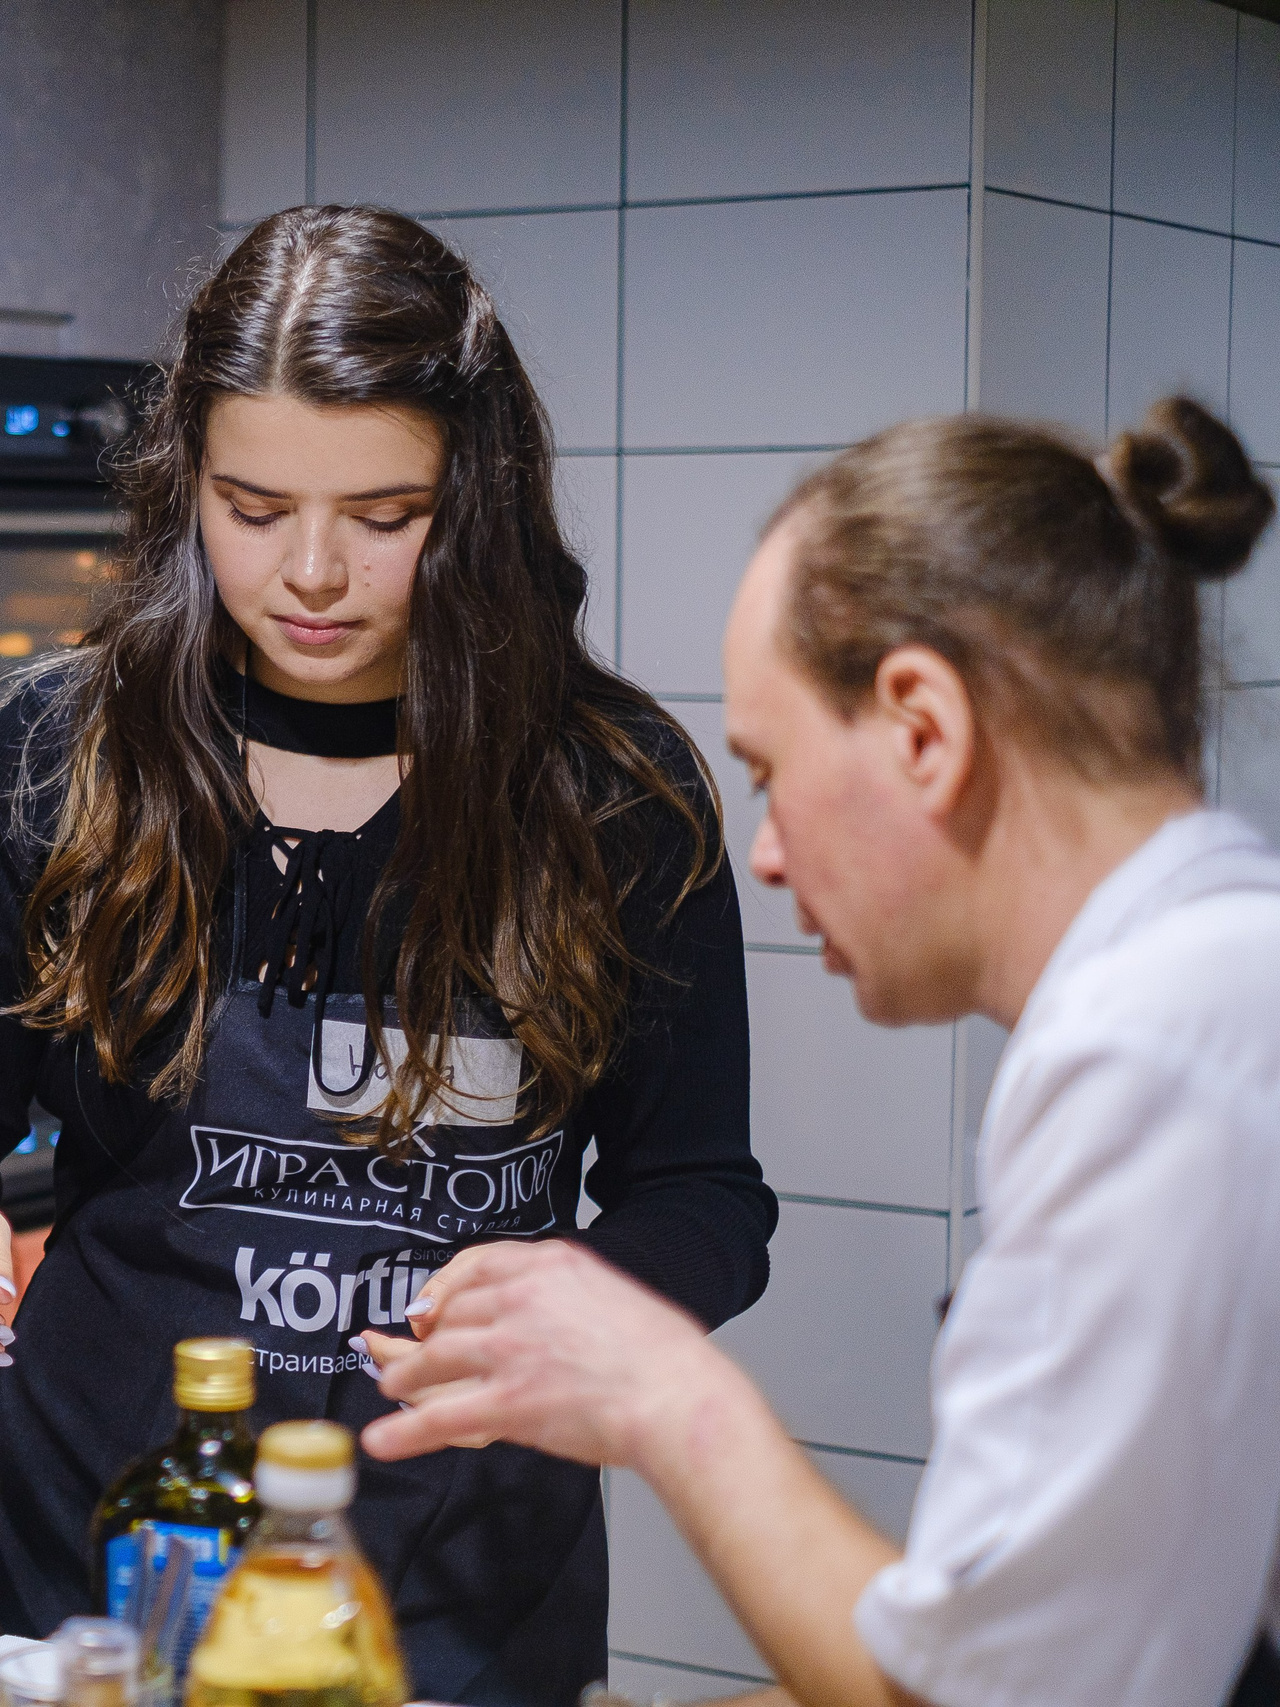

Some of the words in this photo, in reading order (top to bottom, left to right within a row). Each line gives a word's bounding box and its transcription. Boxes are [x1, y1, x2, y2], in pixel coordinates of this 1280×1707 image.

[207, 1137, 350, 1188] ИГРА
[254, 1187, 423, 1222] КУЛИНАРНАЯ
[234, 1246, 442, 1333] körti
